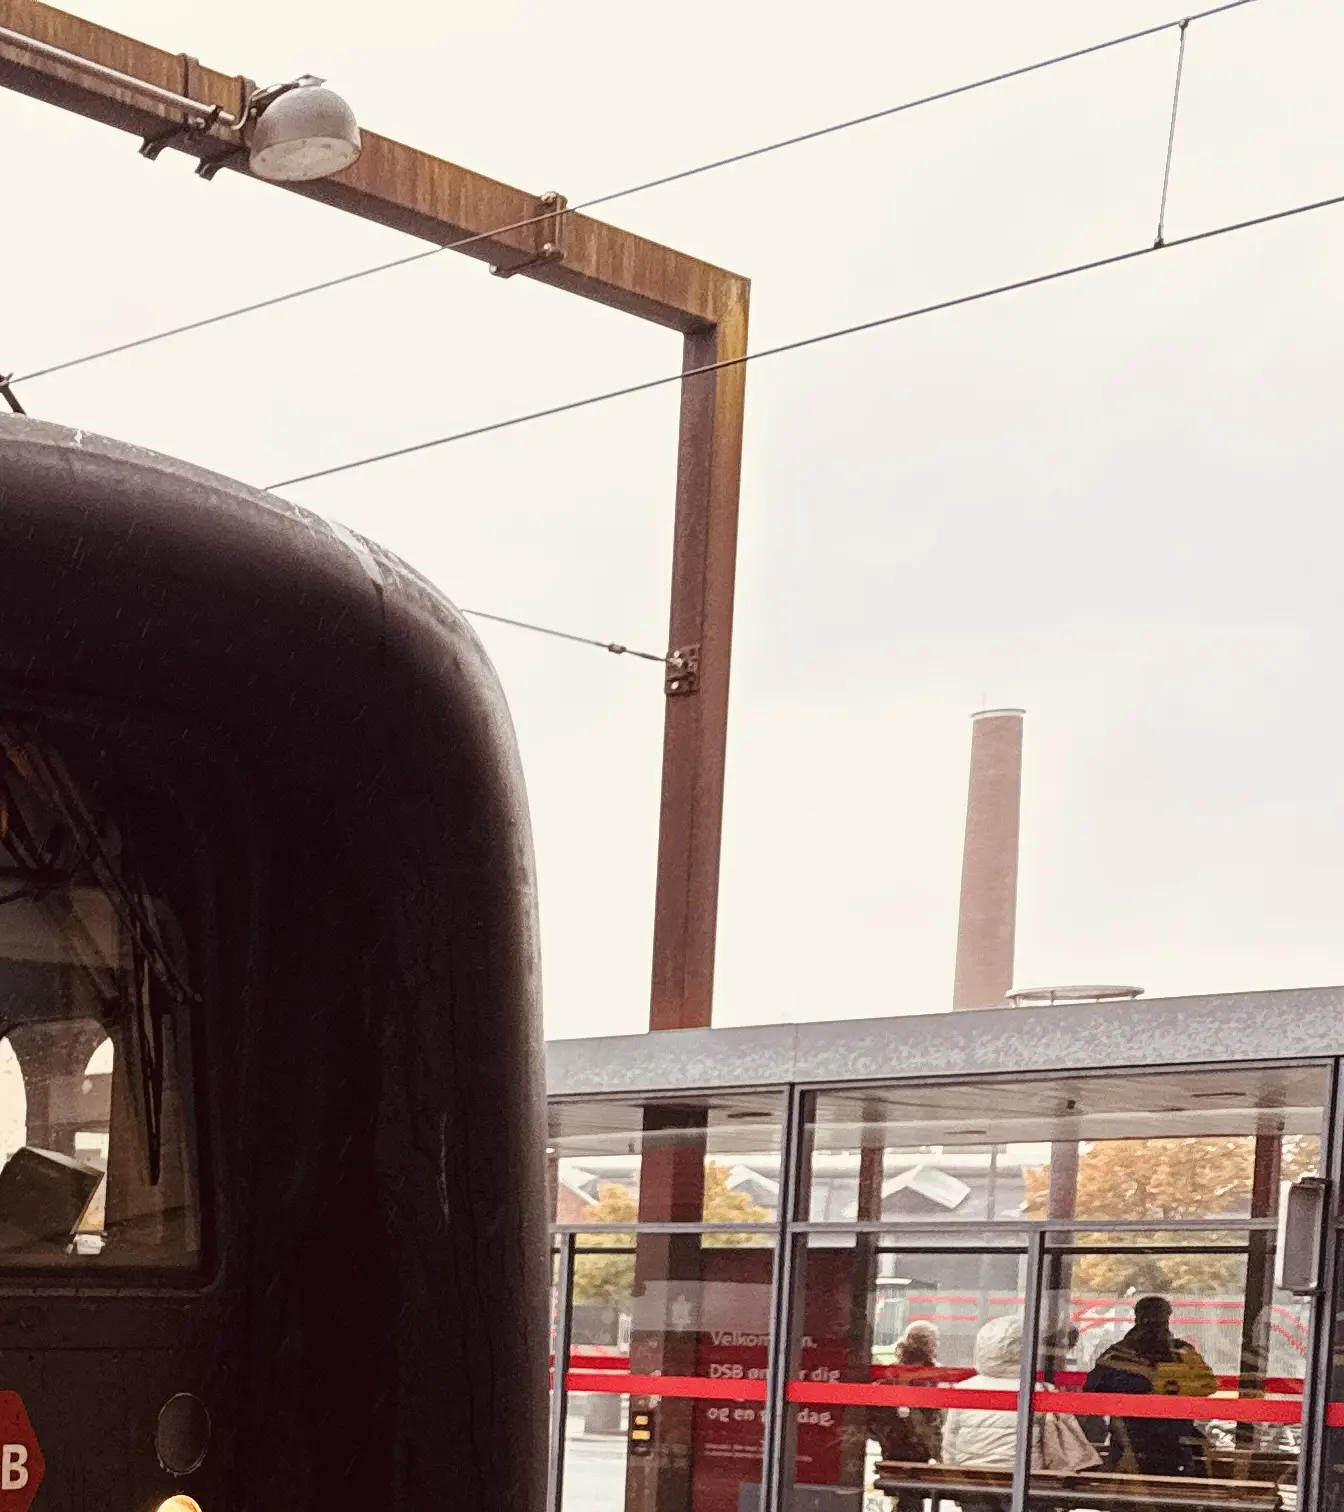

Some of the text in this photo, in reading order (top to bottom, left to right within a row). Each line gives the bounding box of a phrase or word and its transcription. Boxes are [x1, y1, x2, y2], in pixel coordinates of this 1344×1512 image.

[711, 1330, 818, 1349] Velkon.
[709, 1363, 744, 1379] DSB
[733, 1408, 755, 1421] en
